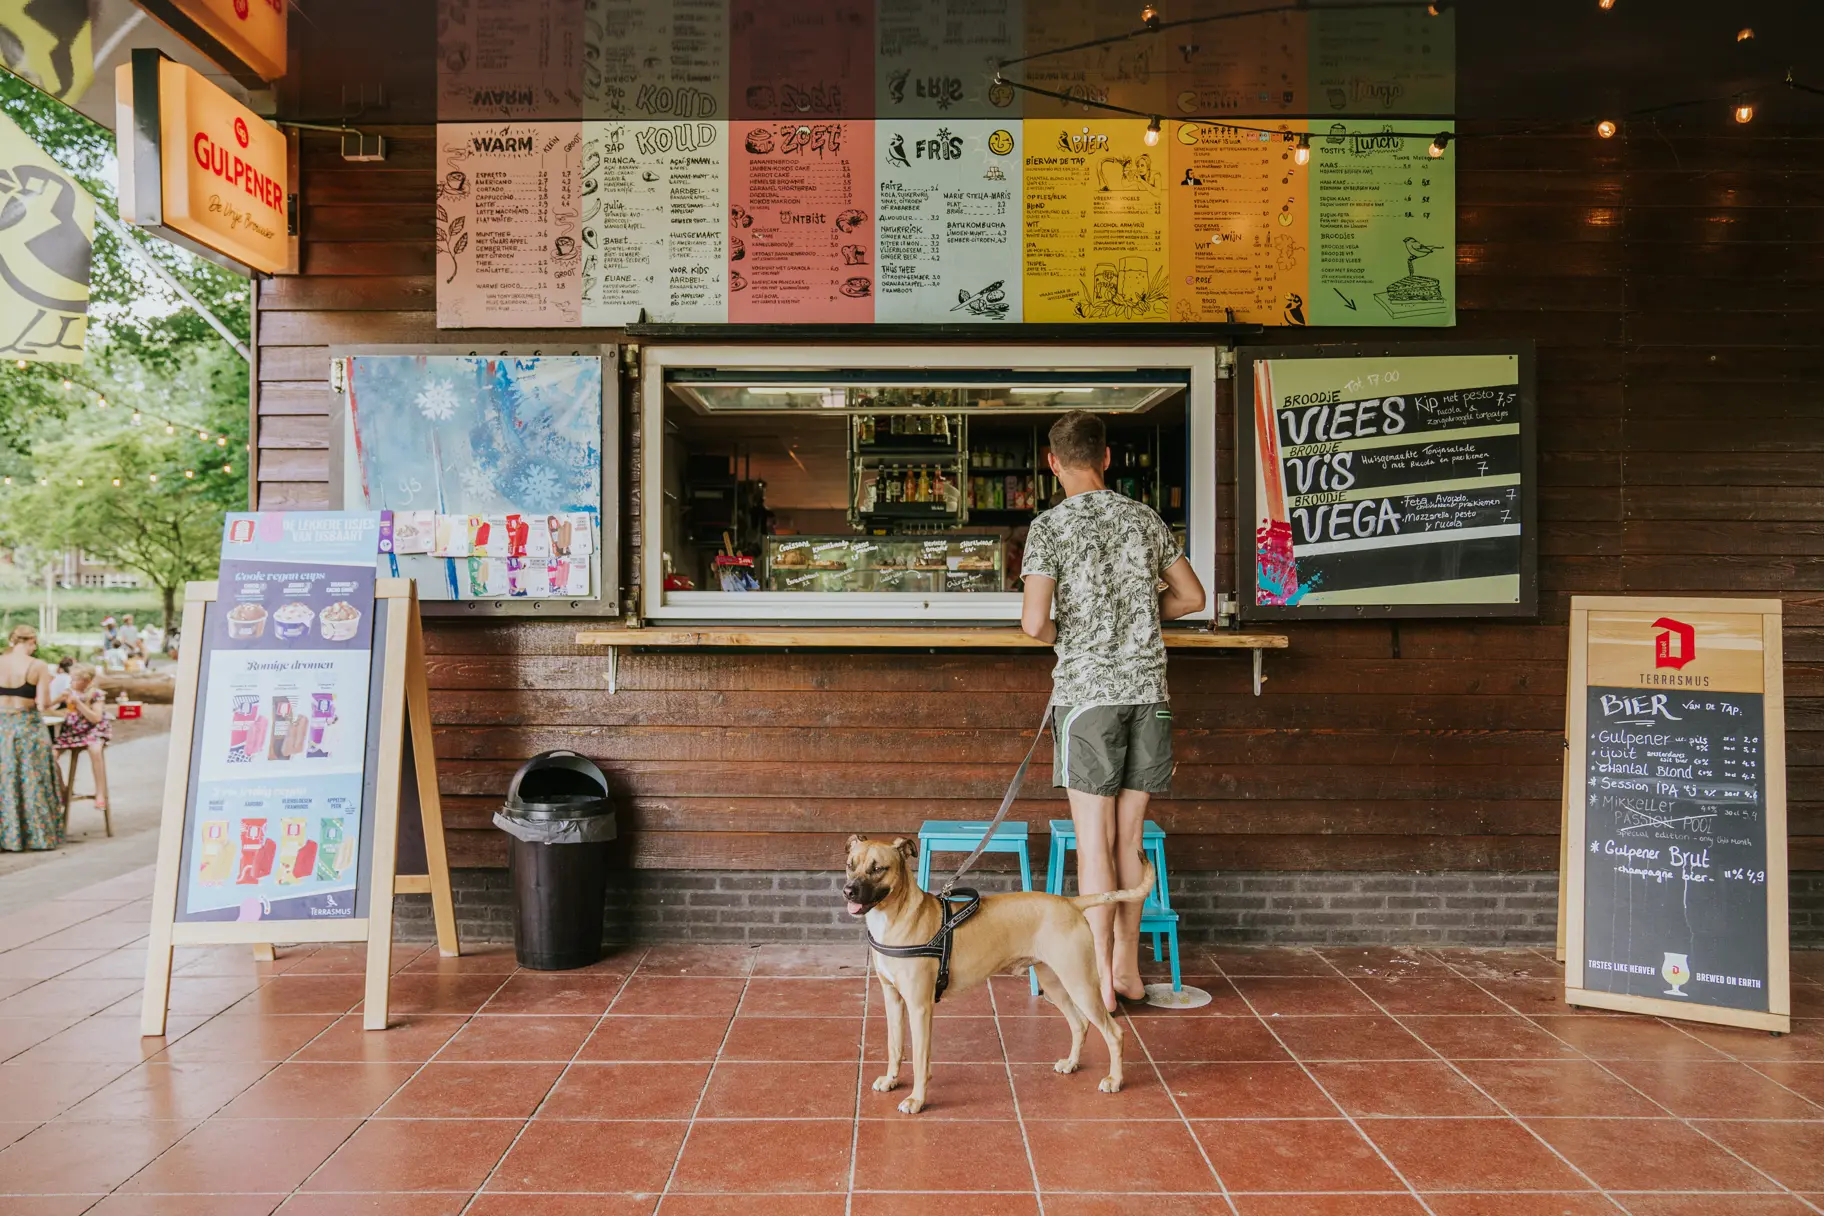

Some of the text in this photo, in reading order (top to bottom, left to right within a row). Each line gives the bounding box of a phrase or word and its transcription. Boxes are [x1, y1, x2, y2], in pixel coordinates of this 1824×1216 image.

[472, 136, 533, 152] WARM
[636, 123, 716, 155] KOUD
[1072, 127, 1109, 154] BIER
[604, 144, 624, 153] SAP
[916, 136, 963, 160] FRIS
[193, 132, 283, 215] GULPENER
[1415, 396, 1438, 413] Kip
[1463, 390, 1494, 407] pesto
[1477, 462, 1488, 477] 7
[1506, 489, 1517, 500] 7
[1293, 498, 1402, 543] VEGA
[1454, 510, 1476, 522] pesto
[1500, 509, 1511, 522] 7
[1434, 520, 1463, 529] rucola
[1640, 673, 1710, 687] TERRASMUS
[1598, 730, 1670, 749] Gulpener
[1601, 776, 1649, 792] Session
[1605, 840, 1710, 868] Gulpener Brut
[311, 907, 351, 916] TERRASMUS
[1588, 959, 1655, 976] TASTES LIKE HEAVEN
[1696, 972, 1761, 989] BREWED ON EARTH
